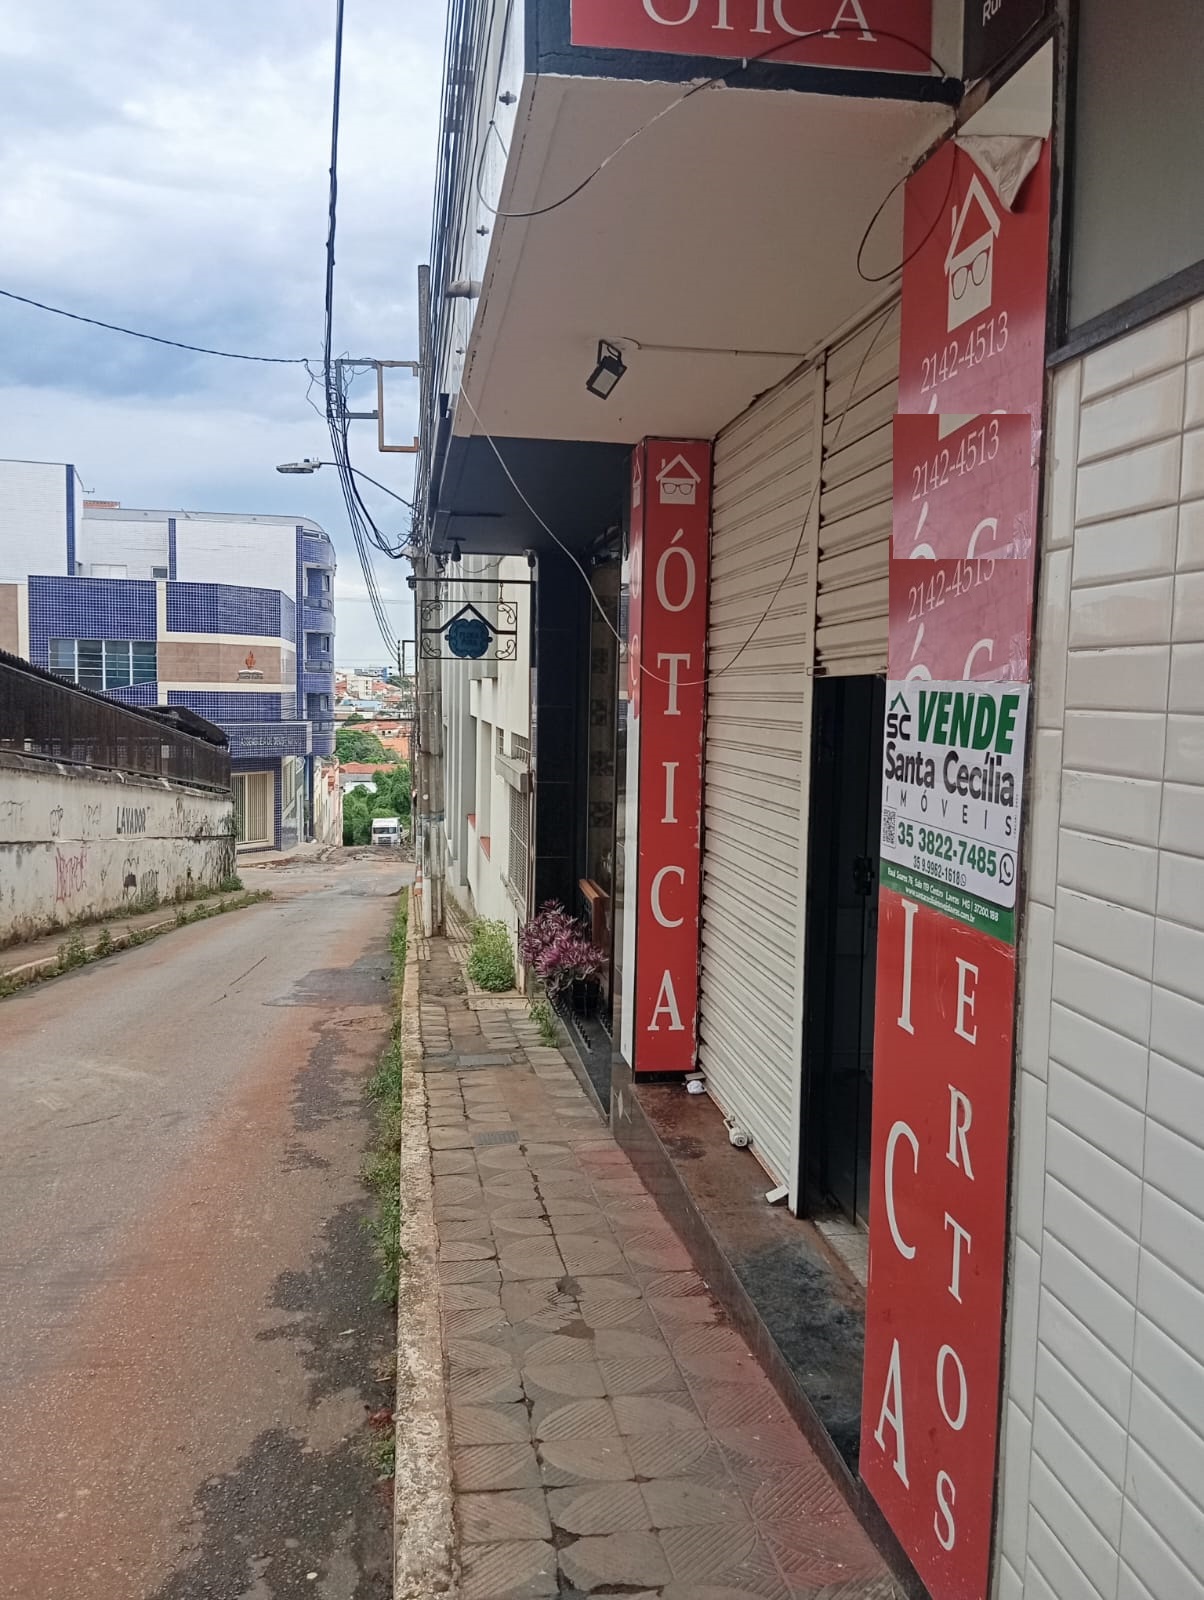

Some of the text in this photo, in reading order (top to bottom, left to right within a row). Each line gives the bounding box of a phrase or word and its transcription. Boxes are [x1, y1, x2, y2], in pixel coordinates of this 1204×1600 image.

[920, 311, 1009, 394] 2142-4513
[911, 418, 1000, 502] 2142-4513
[917, 690, 1020, 755] VENDE
[647, 528, 697, 1032] ÓTICA
[885, 740, 1014, 807] Santa Cecília
[885, 785, 1012, 836] IMÓVEIS
[897, 821, 997, 877] 35 3822-7485
